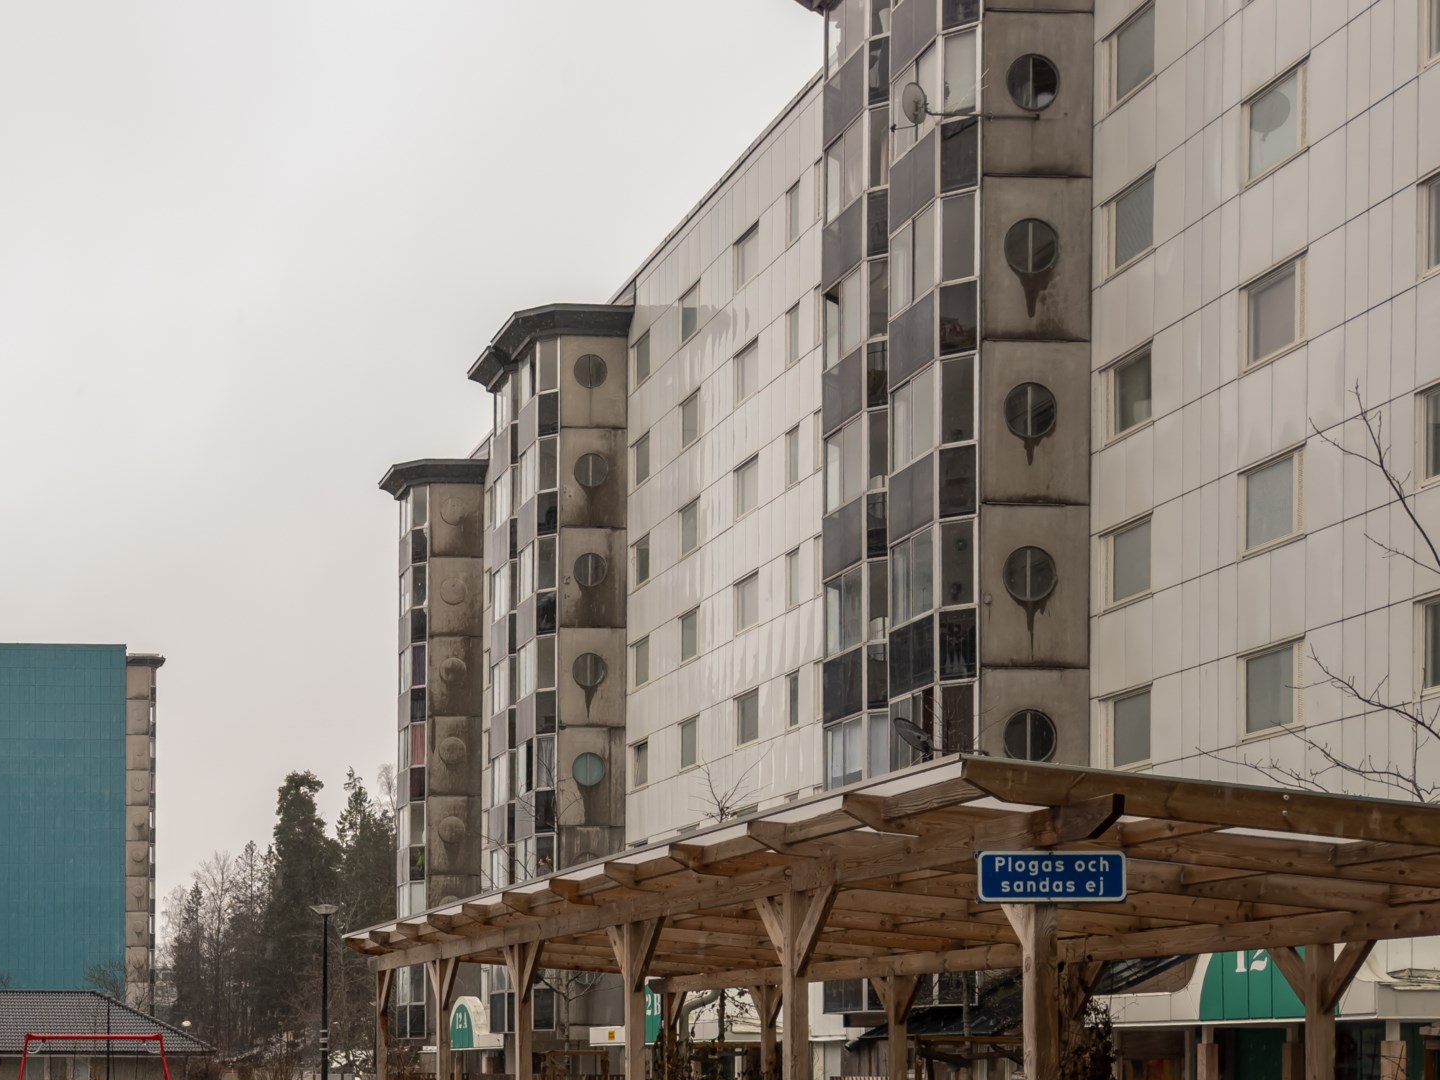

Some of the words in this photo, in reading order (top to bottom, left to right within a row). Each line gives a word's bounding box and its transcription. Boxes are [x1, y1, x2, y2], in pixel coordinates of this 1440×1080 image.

[994, 857, 1065, 876] Plogas
[1074, 857, 1110, 872] och
[1001, 877, 1076, 893] sandas
[1085, 876, 1105, 896] ej
[645, 993, 661, 1016] 2B
